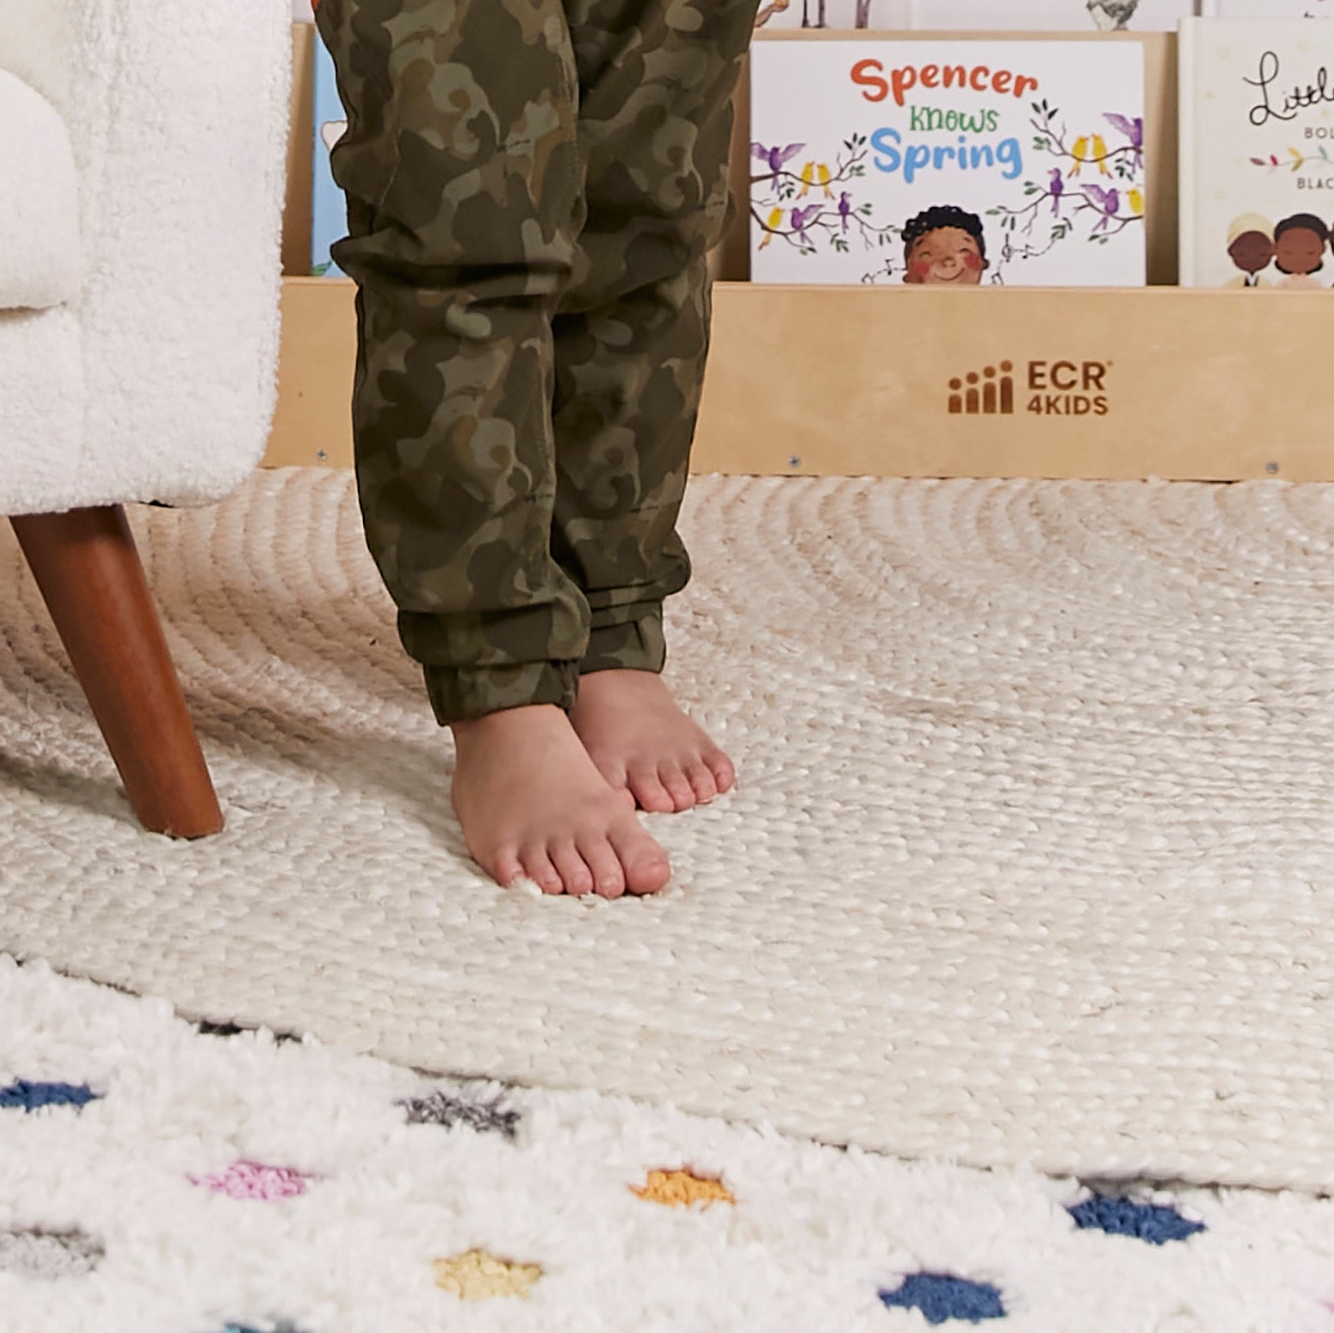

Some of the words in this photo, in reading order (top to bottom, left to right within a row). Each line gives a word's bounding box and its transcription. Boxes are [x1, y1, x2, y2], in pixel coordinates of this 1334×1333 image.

[849, 58, 1039, 108] Spencer
[869, 126, 1024, 185] Spring
[1028, 360, 1106, 391] ECR
[1026, 394, 1109, 415] 4KIDS
